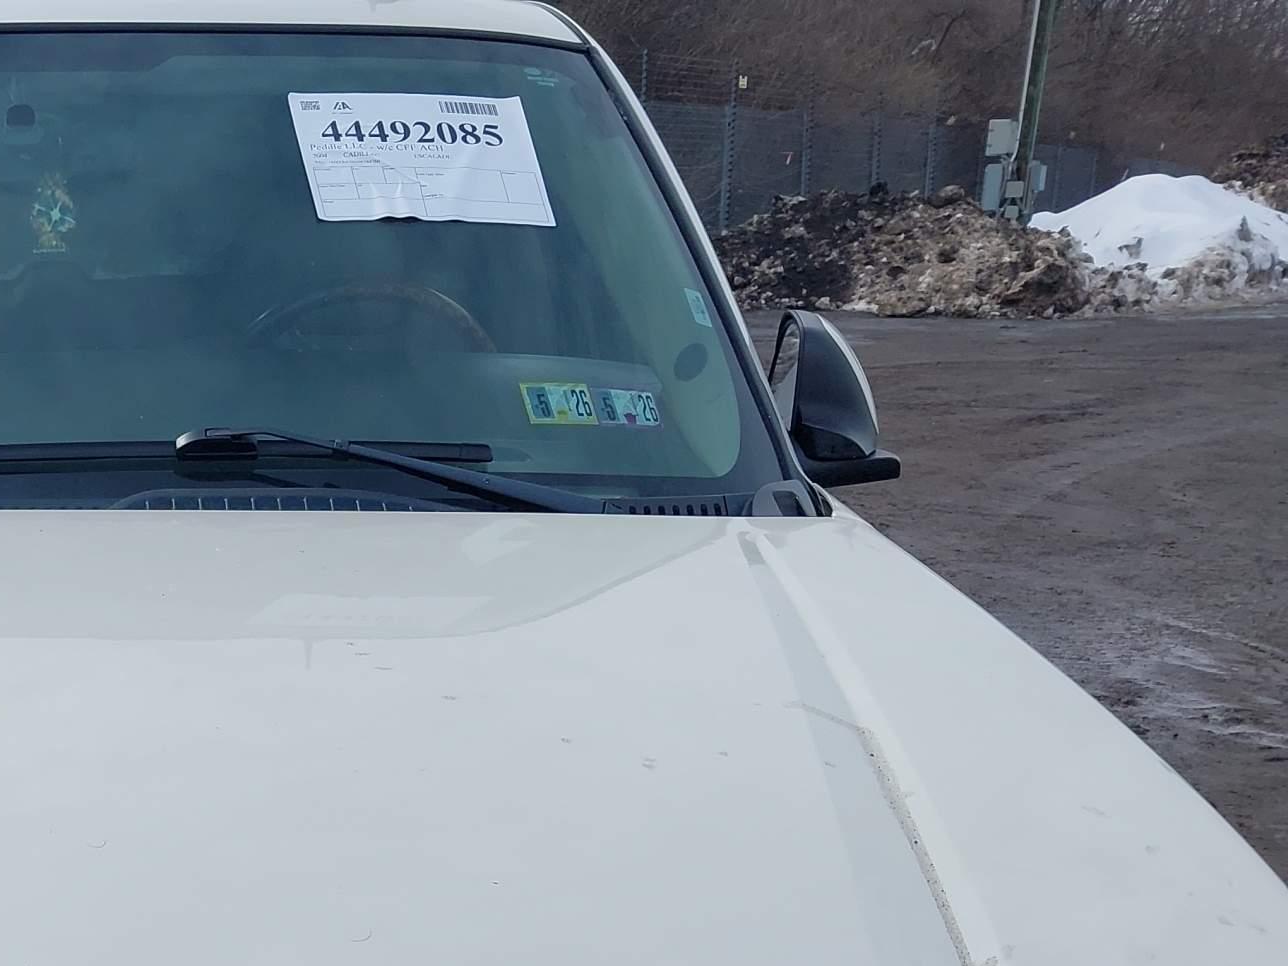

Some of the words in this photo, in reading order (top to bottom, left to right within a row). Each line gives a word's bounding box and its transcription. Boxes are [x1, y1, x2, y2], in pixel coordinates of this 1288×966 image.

[310, 143, 342, 151] Peddle
[321, 119, 504, 147] 44492085
[571, 389, 593, 417] 26
[637, 394, 659, 423] 26
